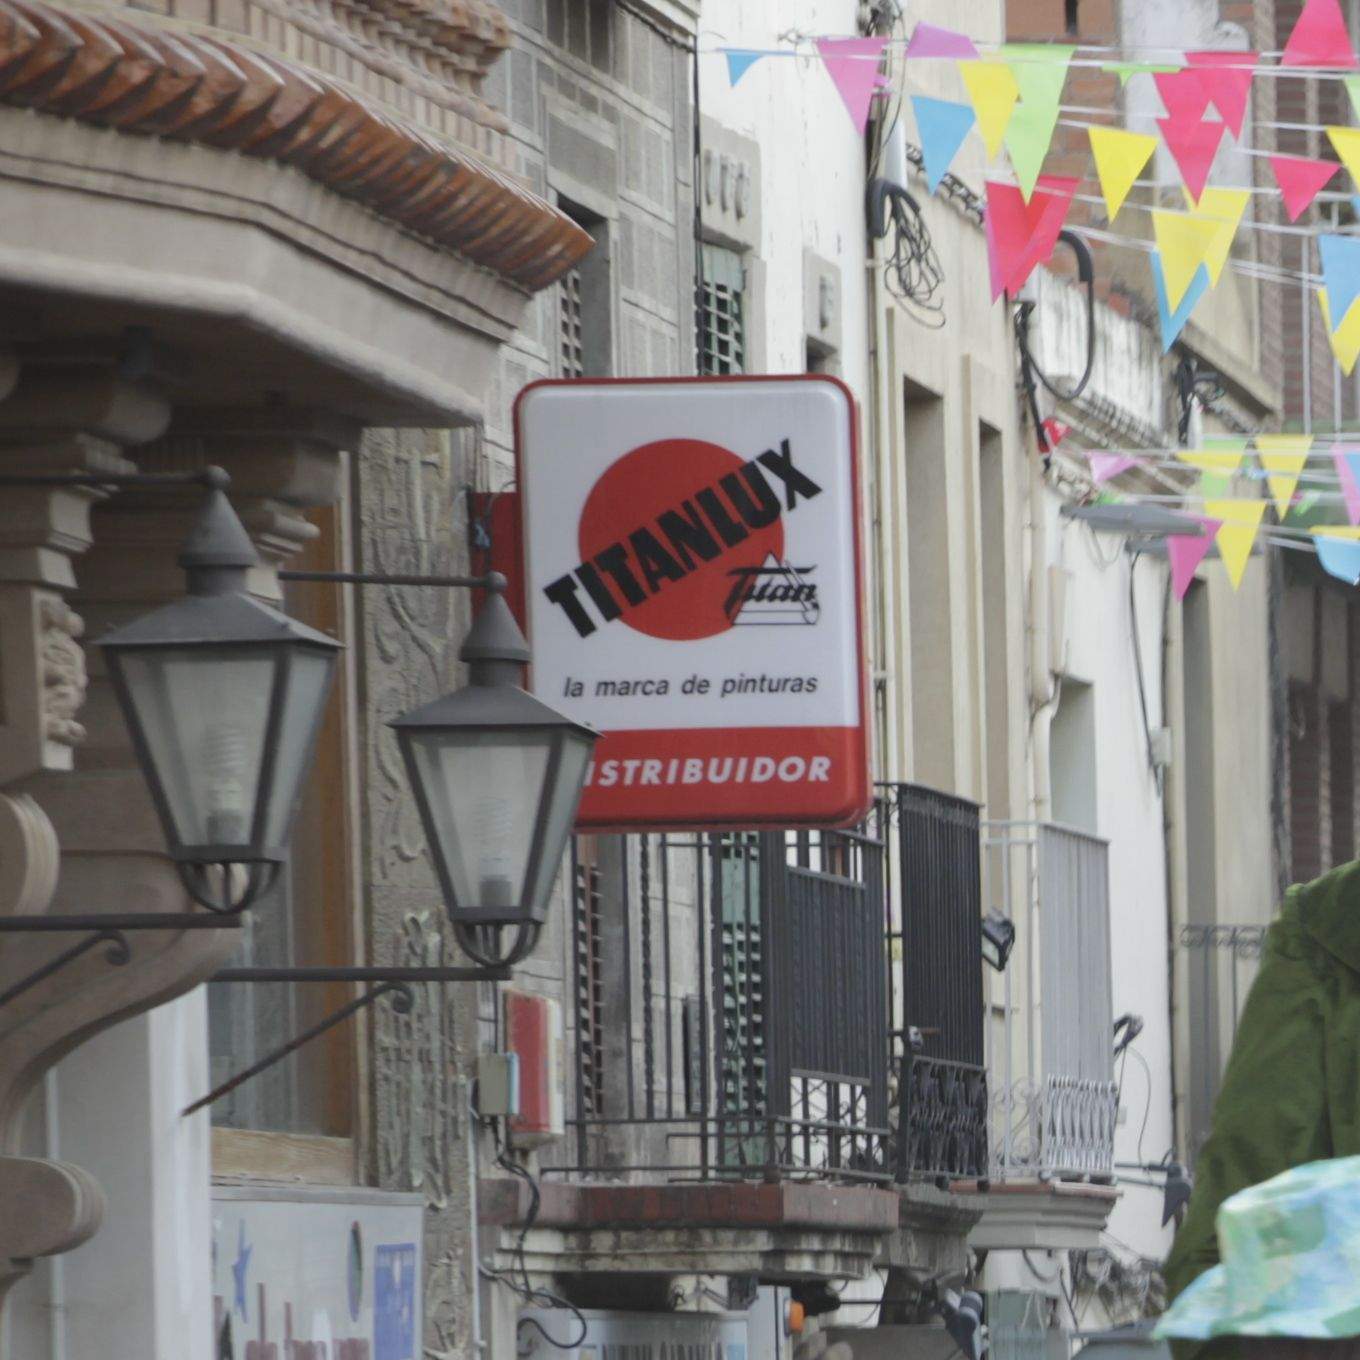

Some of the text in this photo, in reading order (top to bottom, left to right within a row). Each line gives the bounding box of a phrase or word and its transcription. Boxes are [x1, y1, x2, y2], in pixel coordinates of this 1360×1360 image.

[542, 438, 823, 639] TITANLUX
[563, 672, 819, 698] la marca de pinturas
